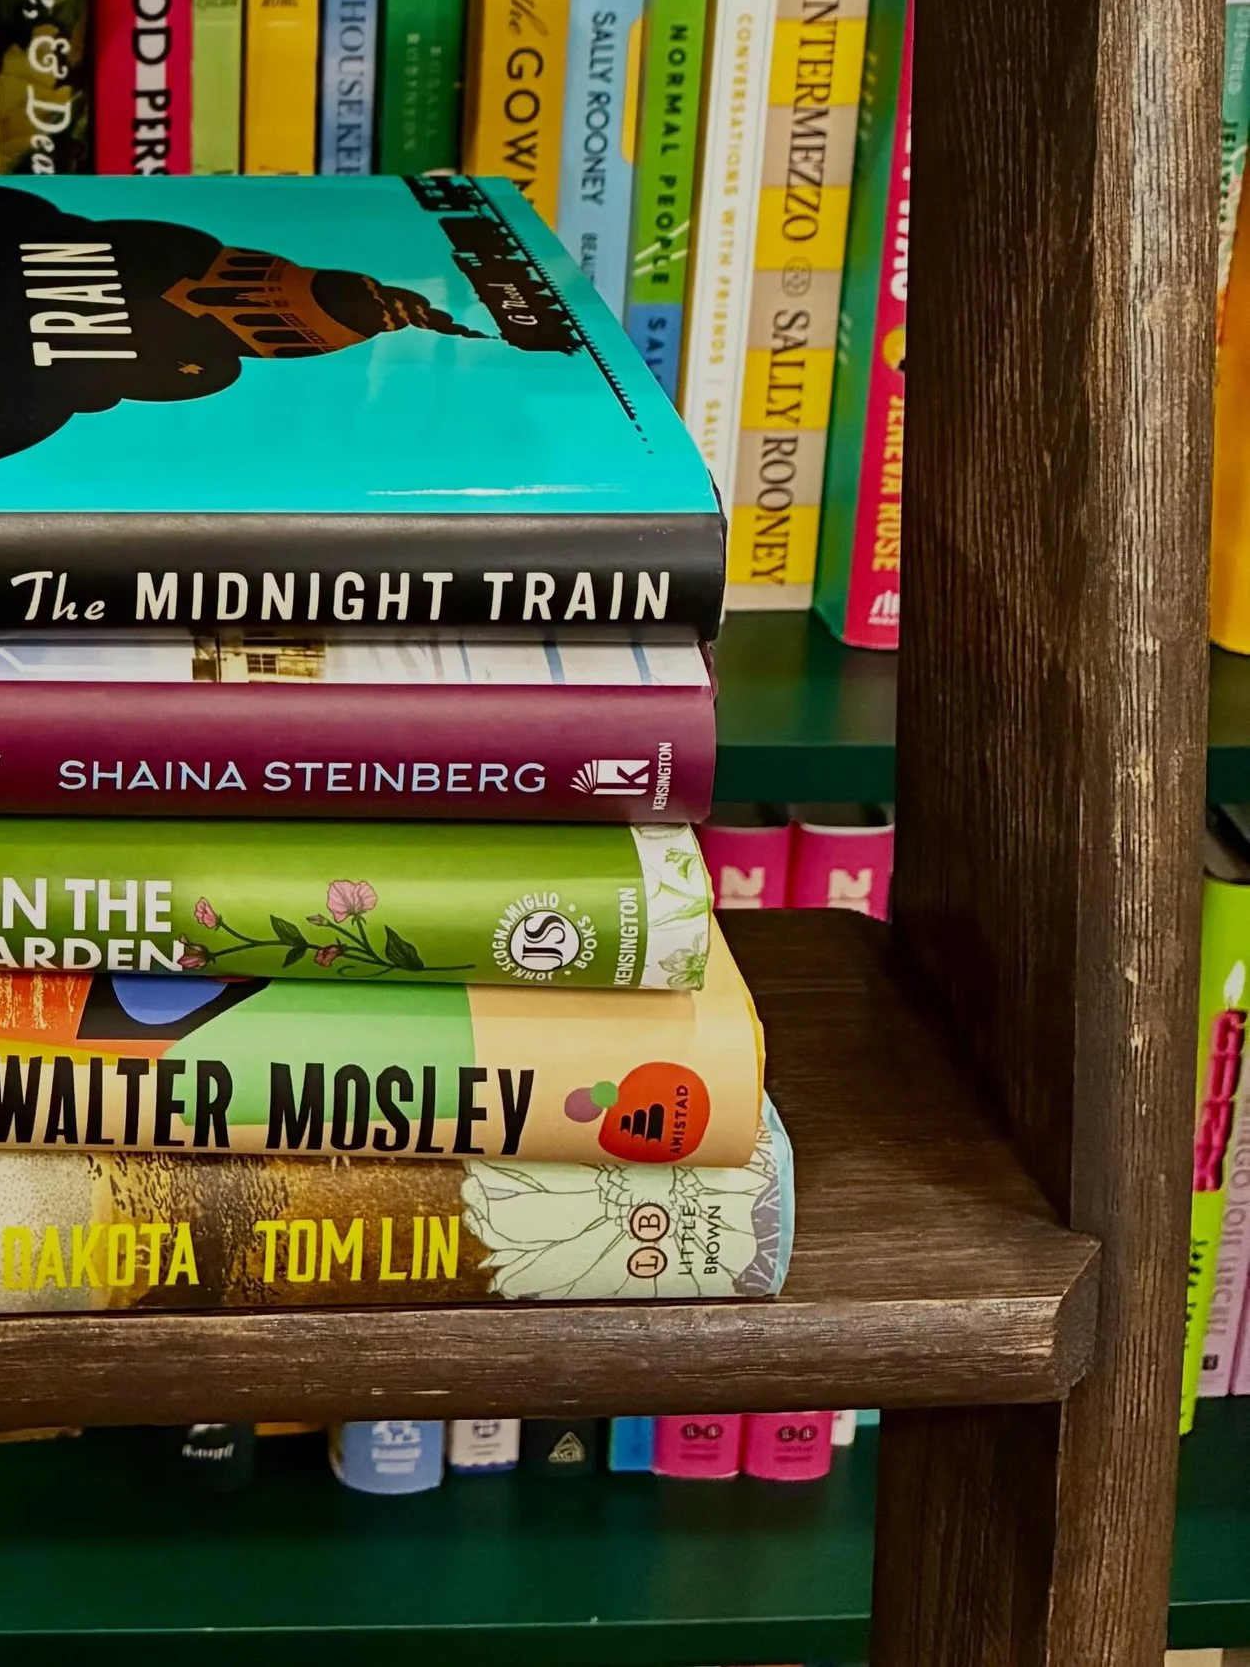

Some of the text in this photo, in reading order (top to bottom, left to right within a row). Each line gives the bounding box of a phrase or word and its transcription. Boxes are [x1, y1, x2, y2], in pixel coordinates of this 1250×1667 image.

[27, 35, 71, 80] &
[580, 10, 617, 207] SALLY ROONEY
[650, 24, 688, 286] NORMAL PEOPLE
[709, 13, 753, 365] CONVERSATIONS WITH FRIENDS
[19, 242, 138, 367] TRAIN
[645, 315, 668, 380] SAL
[764, 308, 811, 428] SALLY
[701, 399, 721, 461] SALLY
[751, 434, 799, 587] ROONEY
[9, 570, 673, 622] The MIDNIGHT TRAIN
[58, 759, 547, 794] SHAINA STEINBERG
[651, 741, 673, 811] KENSINGTON
[64, 878, 173, 933] THE
[491, 890, 560, 973] SCOGNAMIGLIO
[576, 913, 599, 971] BOOKS
[613, 887, 640, 987] KENSINGTON
[264, 1061, 535, 1157] MOSLEY
[669, 1084, 689, 1155] AMISTAD
[1, 1221, 200, 1291] DAKOTA
[252, 1214, 461, 1283] TOM LIN
[678, 1203, 697, 1276] LITTLE
[703, 1204, 722, 1275] BROWN
